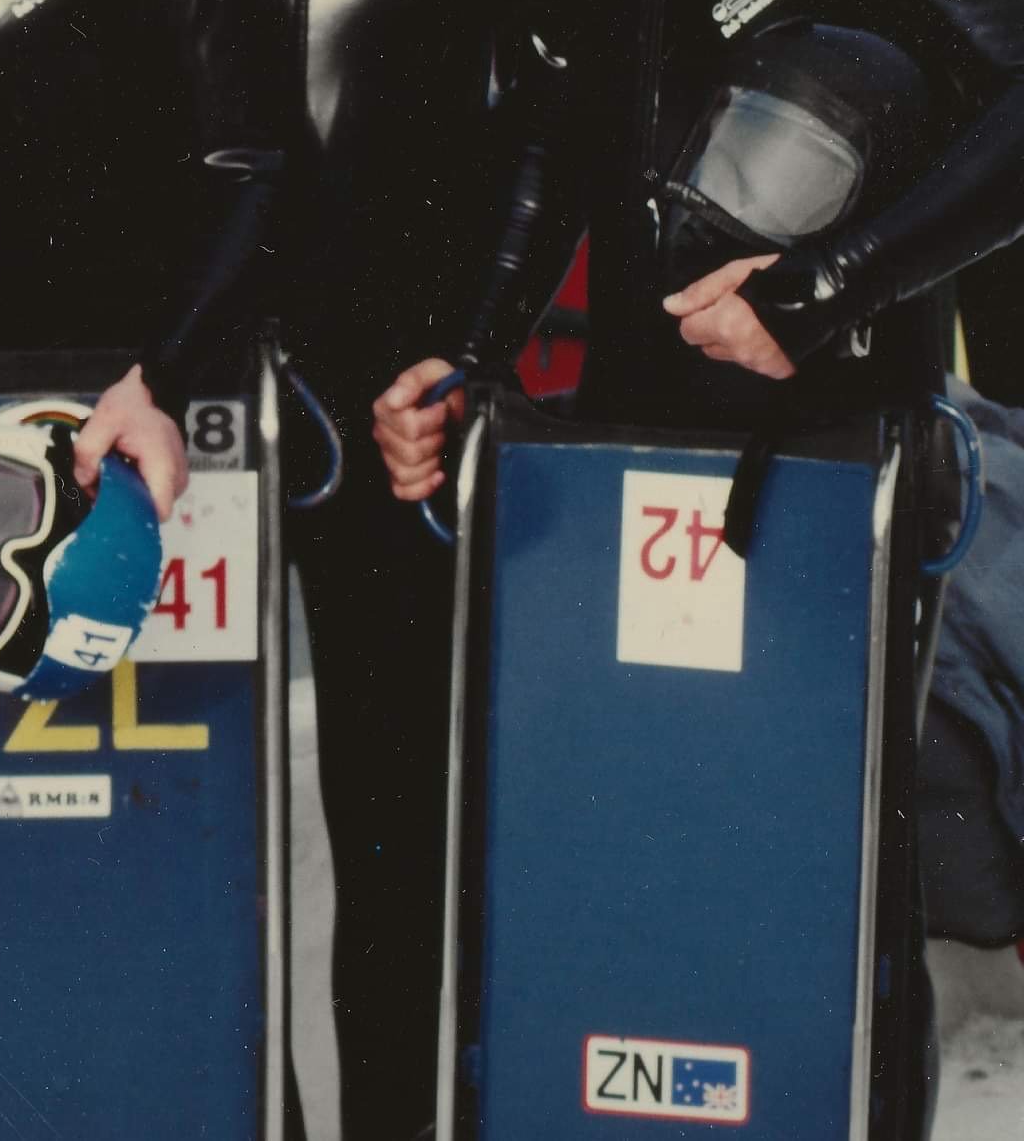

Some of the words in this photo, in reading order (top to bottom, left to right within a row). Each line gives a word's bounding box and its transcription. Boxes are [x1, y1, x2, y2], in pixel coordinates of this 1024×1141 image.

[193, 405, 235, 454] 8
[640, 506, 726, 582] 42
[152, 557, 227, 630] 41
[73, 631, 117, 666] 41
